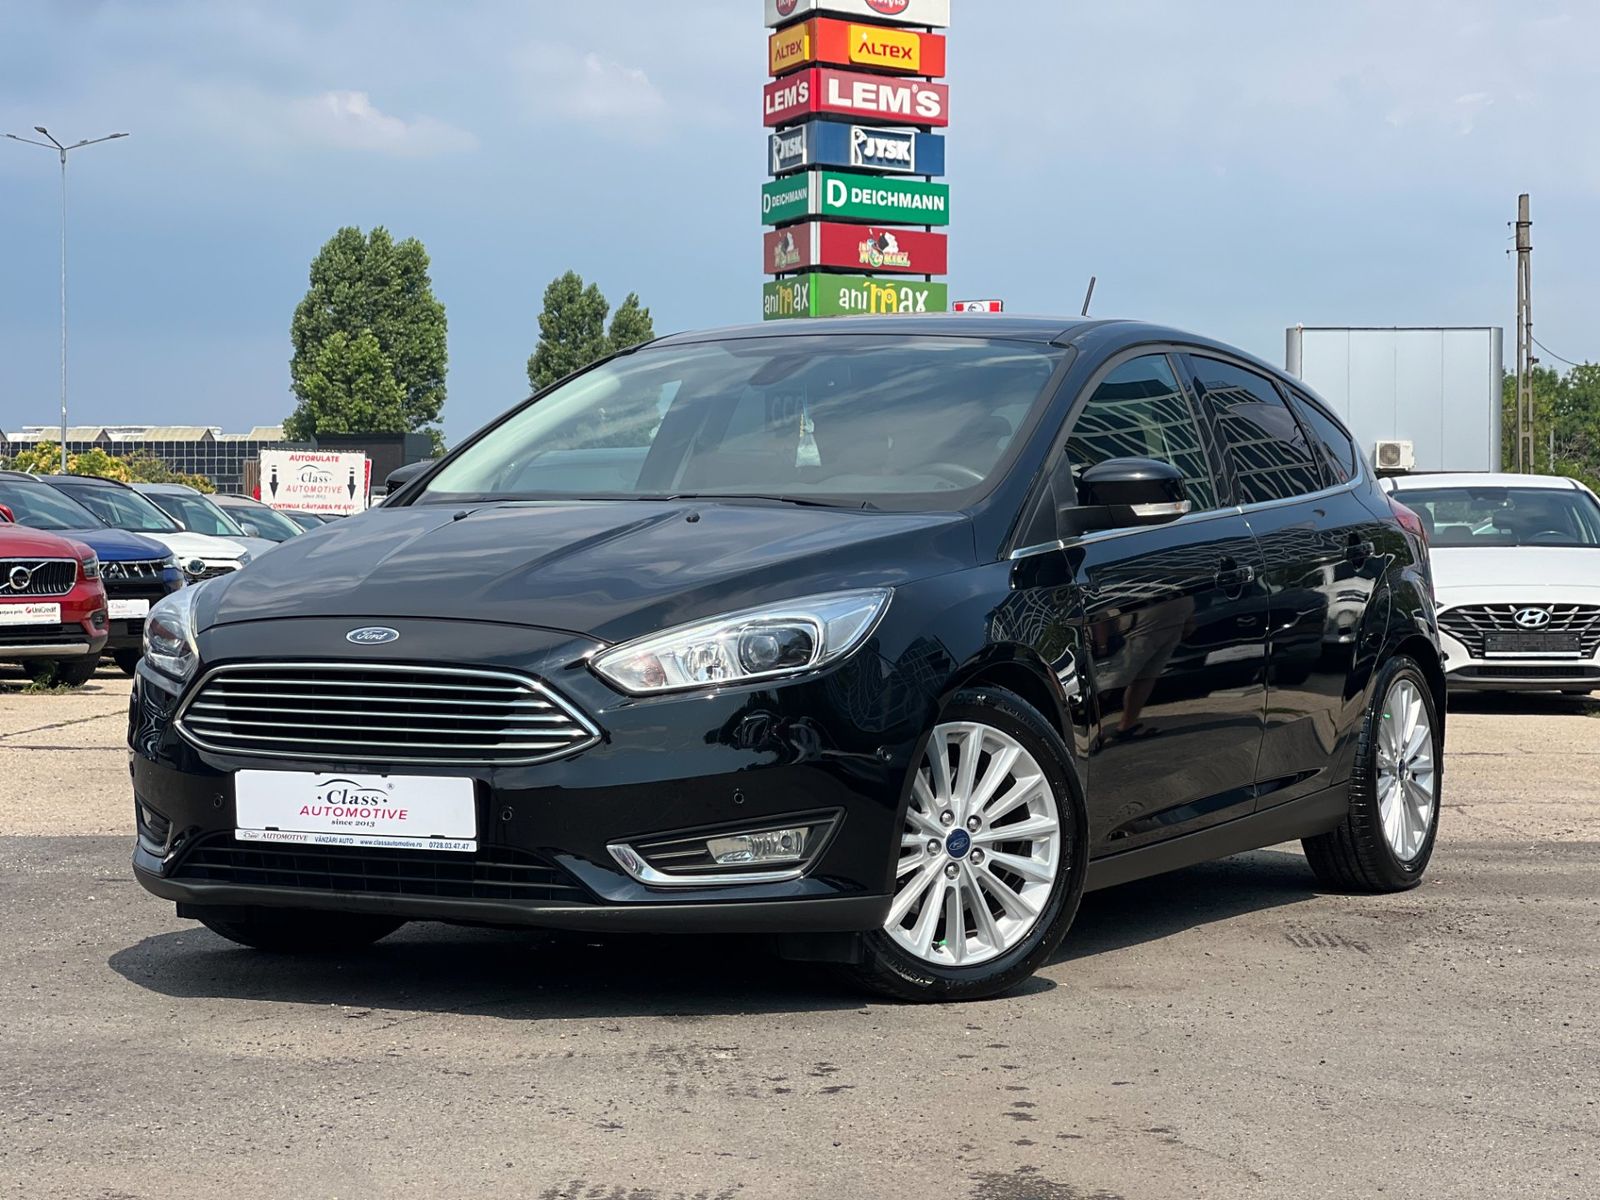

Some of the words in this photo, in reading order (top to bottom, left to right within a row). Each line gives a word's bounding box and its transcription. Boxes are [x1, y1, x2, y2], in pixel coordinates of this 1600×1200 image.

[779, 136, 803, 159] JYSK
[864, 137, 911, 161] JYSK
[772, 187, 808, 207] DEICHMANN
[851, 187, 945, 211] DEICHMANN
[838, 281, 929, 313] animax
[289, 454, 340, 463] AUTORULATE
[301, 472, 329, 483] Class
[285, 484, 343, 494] AUTOMOTIVE
[357, 630, 389, 640] Ford
[326, 789, 379, 806] Class
[299, 805, 408, 820] AUTOMOTIVE
[331, 818, 354, 826] since
[355, 820, 376, 828] 2013
[261, 832, 309, 841] AUTOMOTIVE
[338, 836, 354, 844] AUTO
[360, 839, 423, 848] www.classautomotive.ro
[428, 841, 470, 850] 0728.03.47.47
